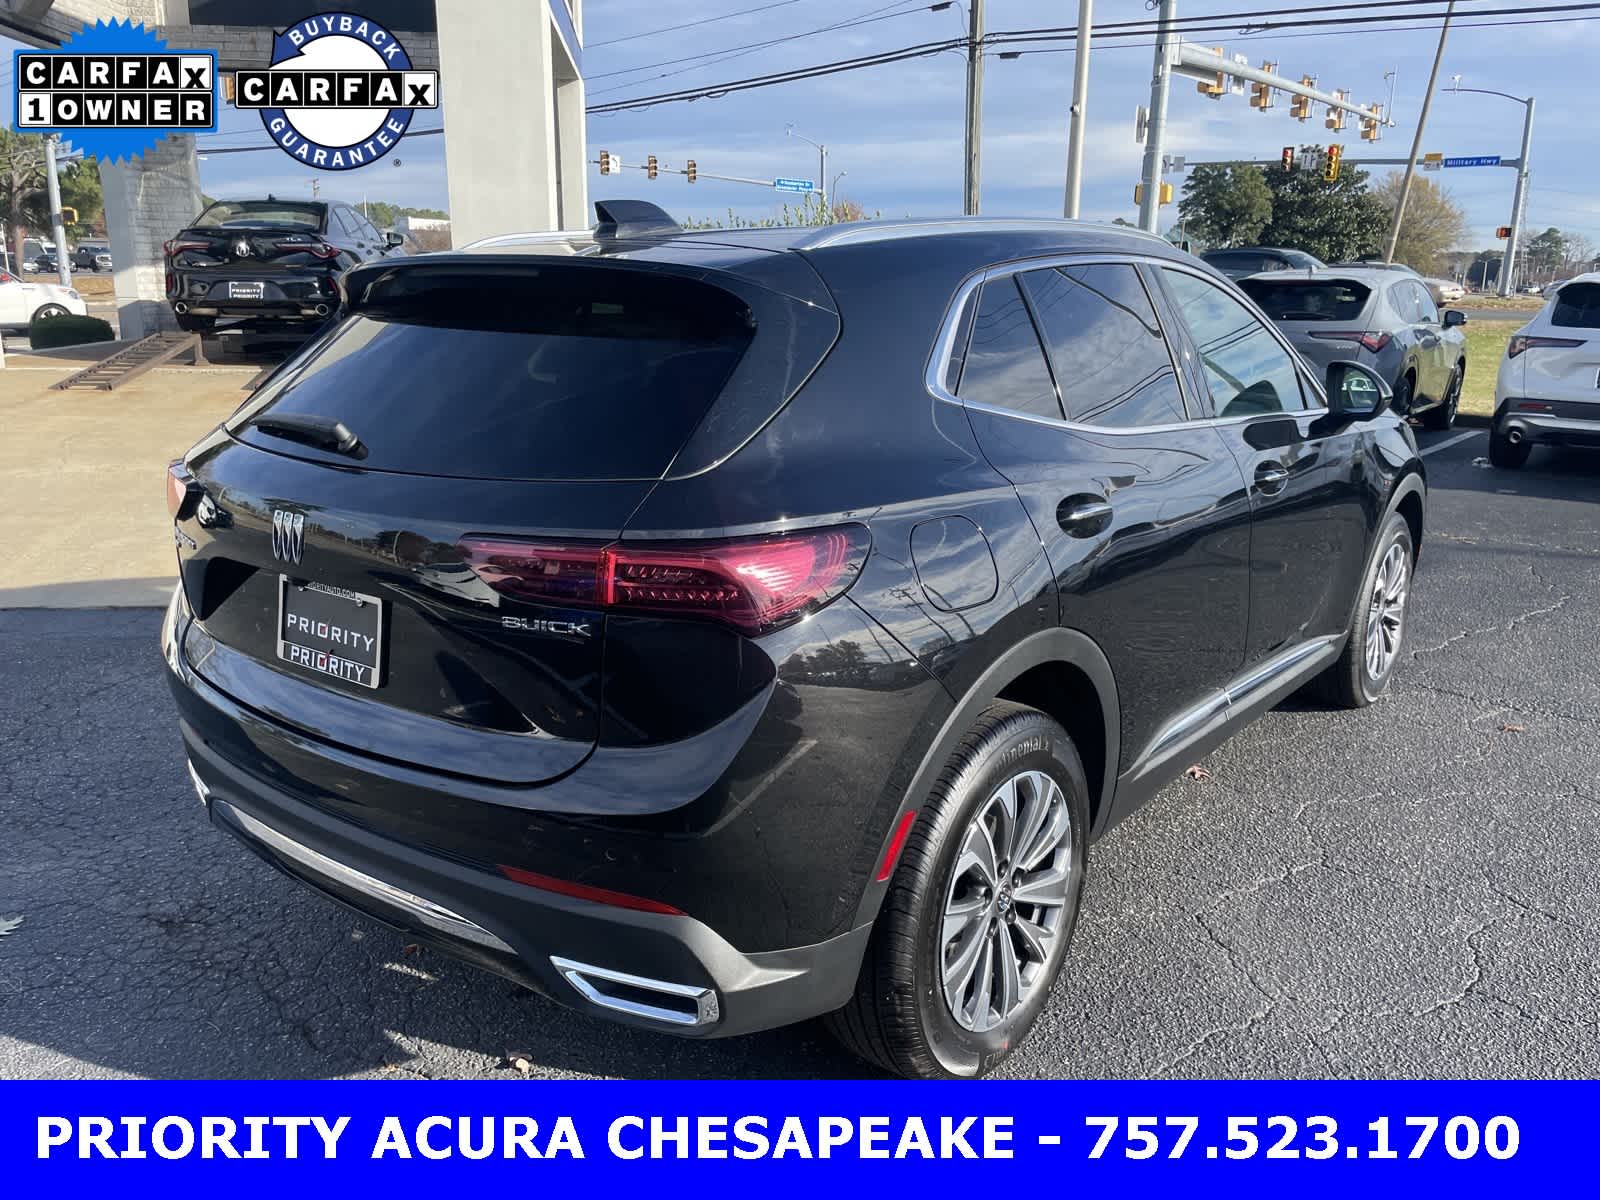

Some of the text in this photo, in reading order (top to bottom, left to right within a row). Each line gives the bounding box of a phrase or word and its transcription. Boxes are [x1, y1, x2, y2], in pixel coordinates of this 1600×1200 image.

[287, 613, 375, 652] PRIORITY
[501, 616, 592, 637] BUICK
[290, 645, 365, 682] PRIORITY
